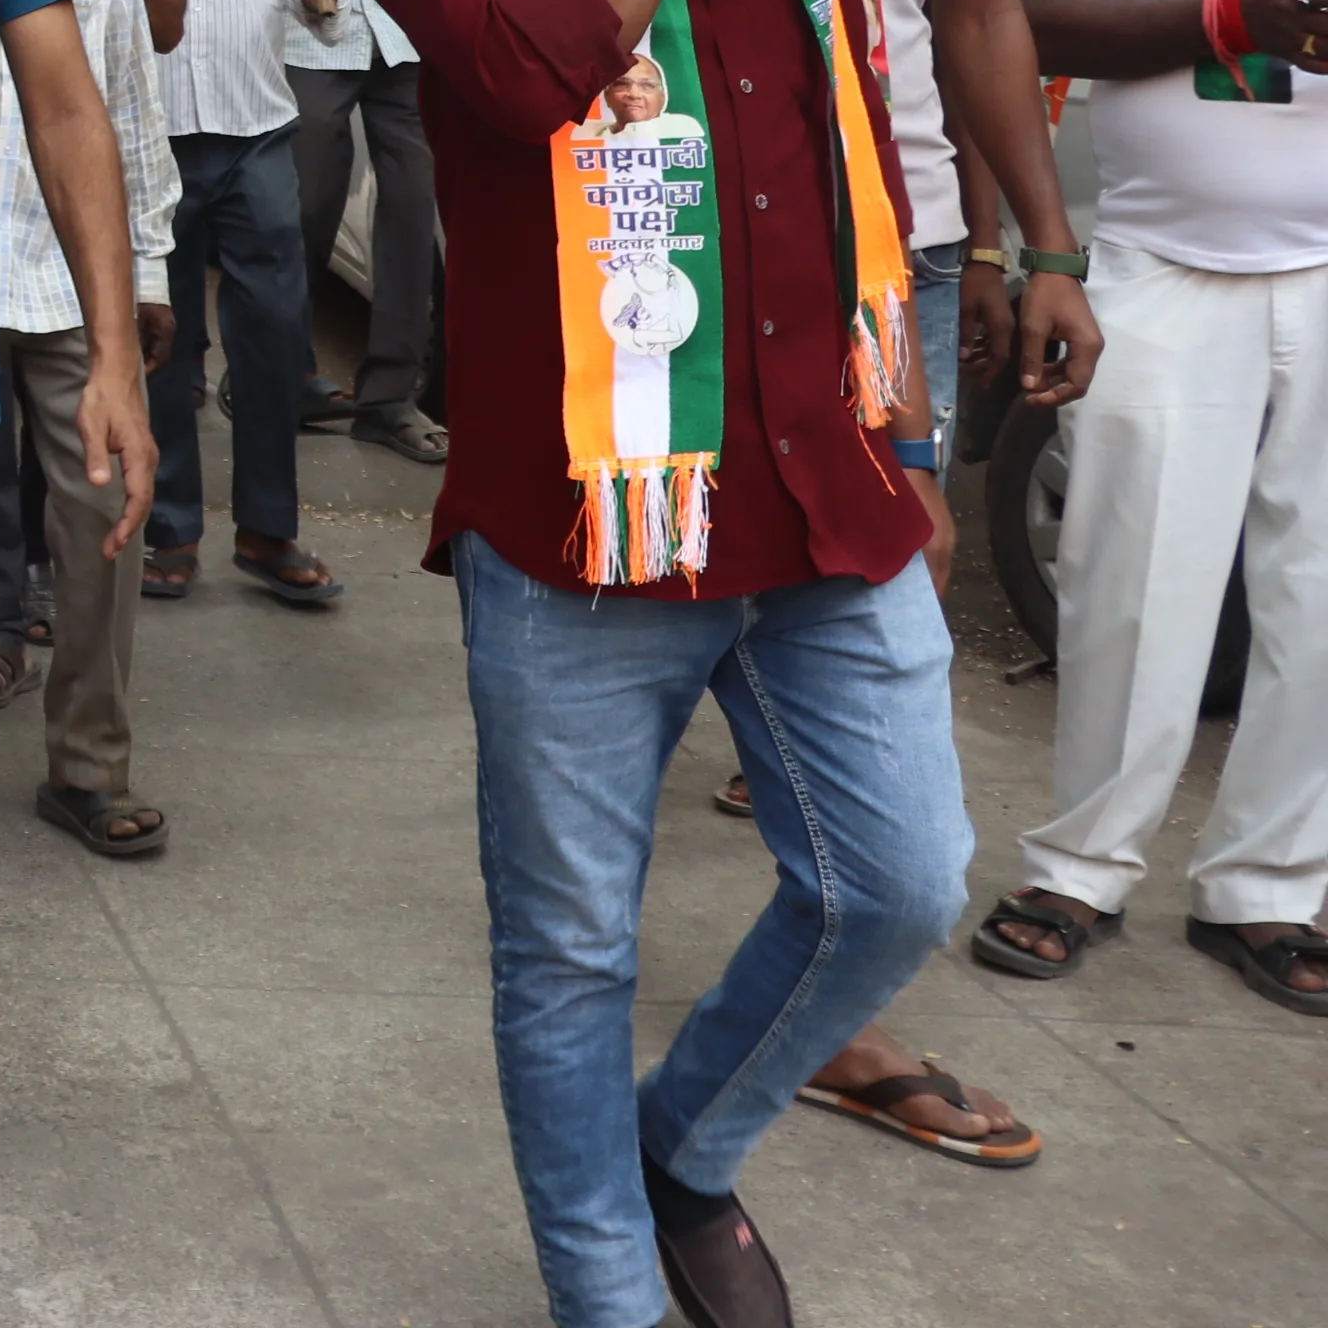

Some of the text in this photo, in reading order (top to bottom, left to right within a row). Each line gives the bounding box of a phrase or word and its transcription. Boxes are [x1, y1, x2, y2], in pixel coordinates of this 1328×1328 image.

[572, 139, 707, 173] राष्ट्रवादी
[584, 177, 702, 207] काँग्रेस
[613, 210, 677, 232] पक्ष
[589, 236, 703, 251] शरदचंद्र पवार
